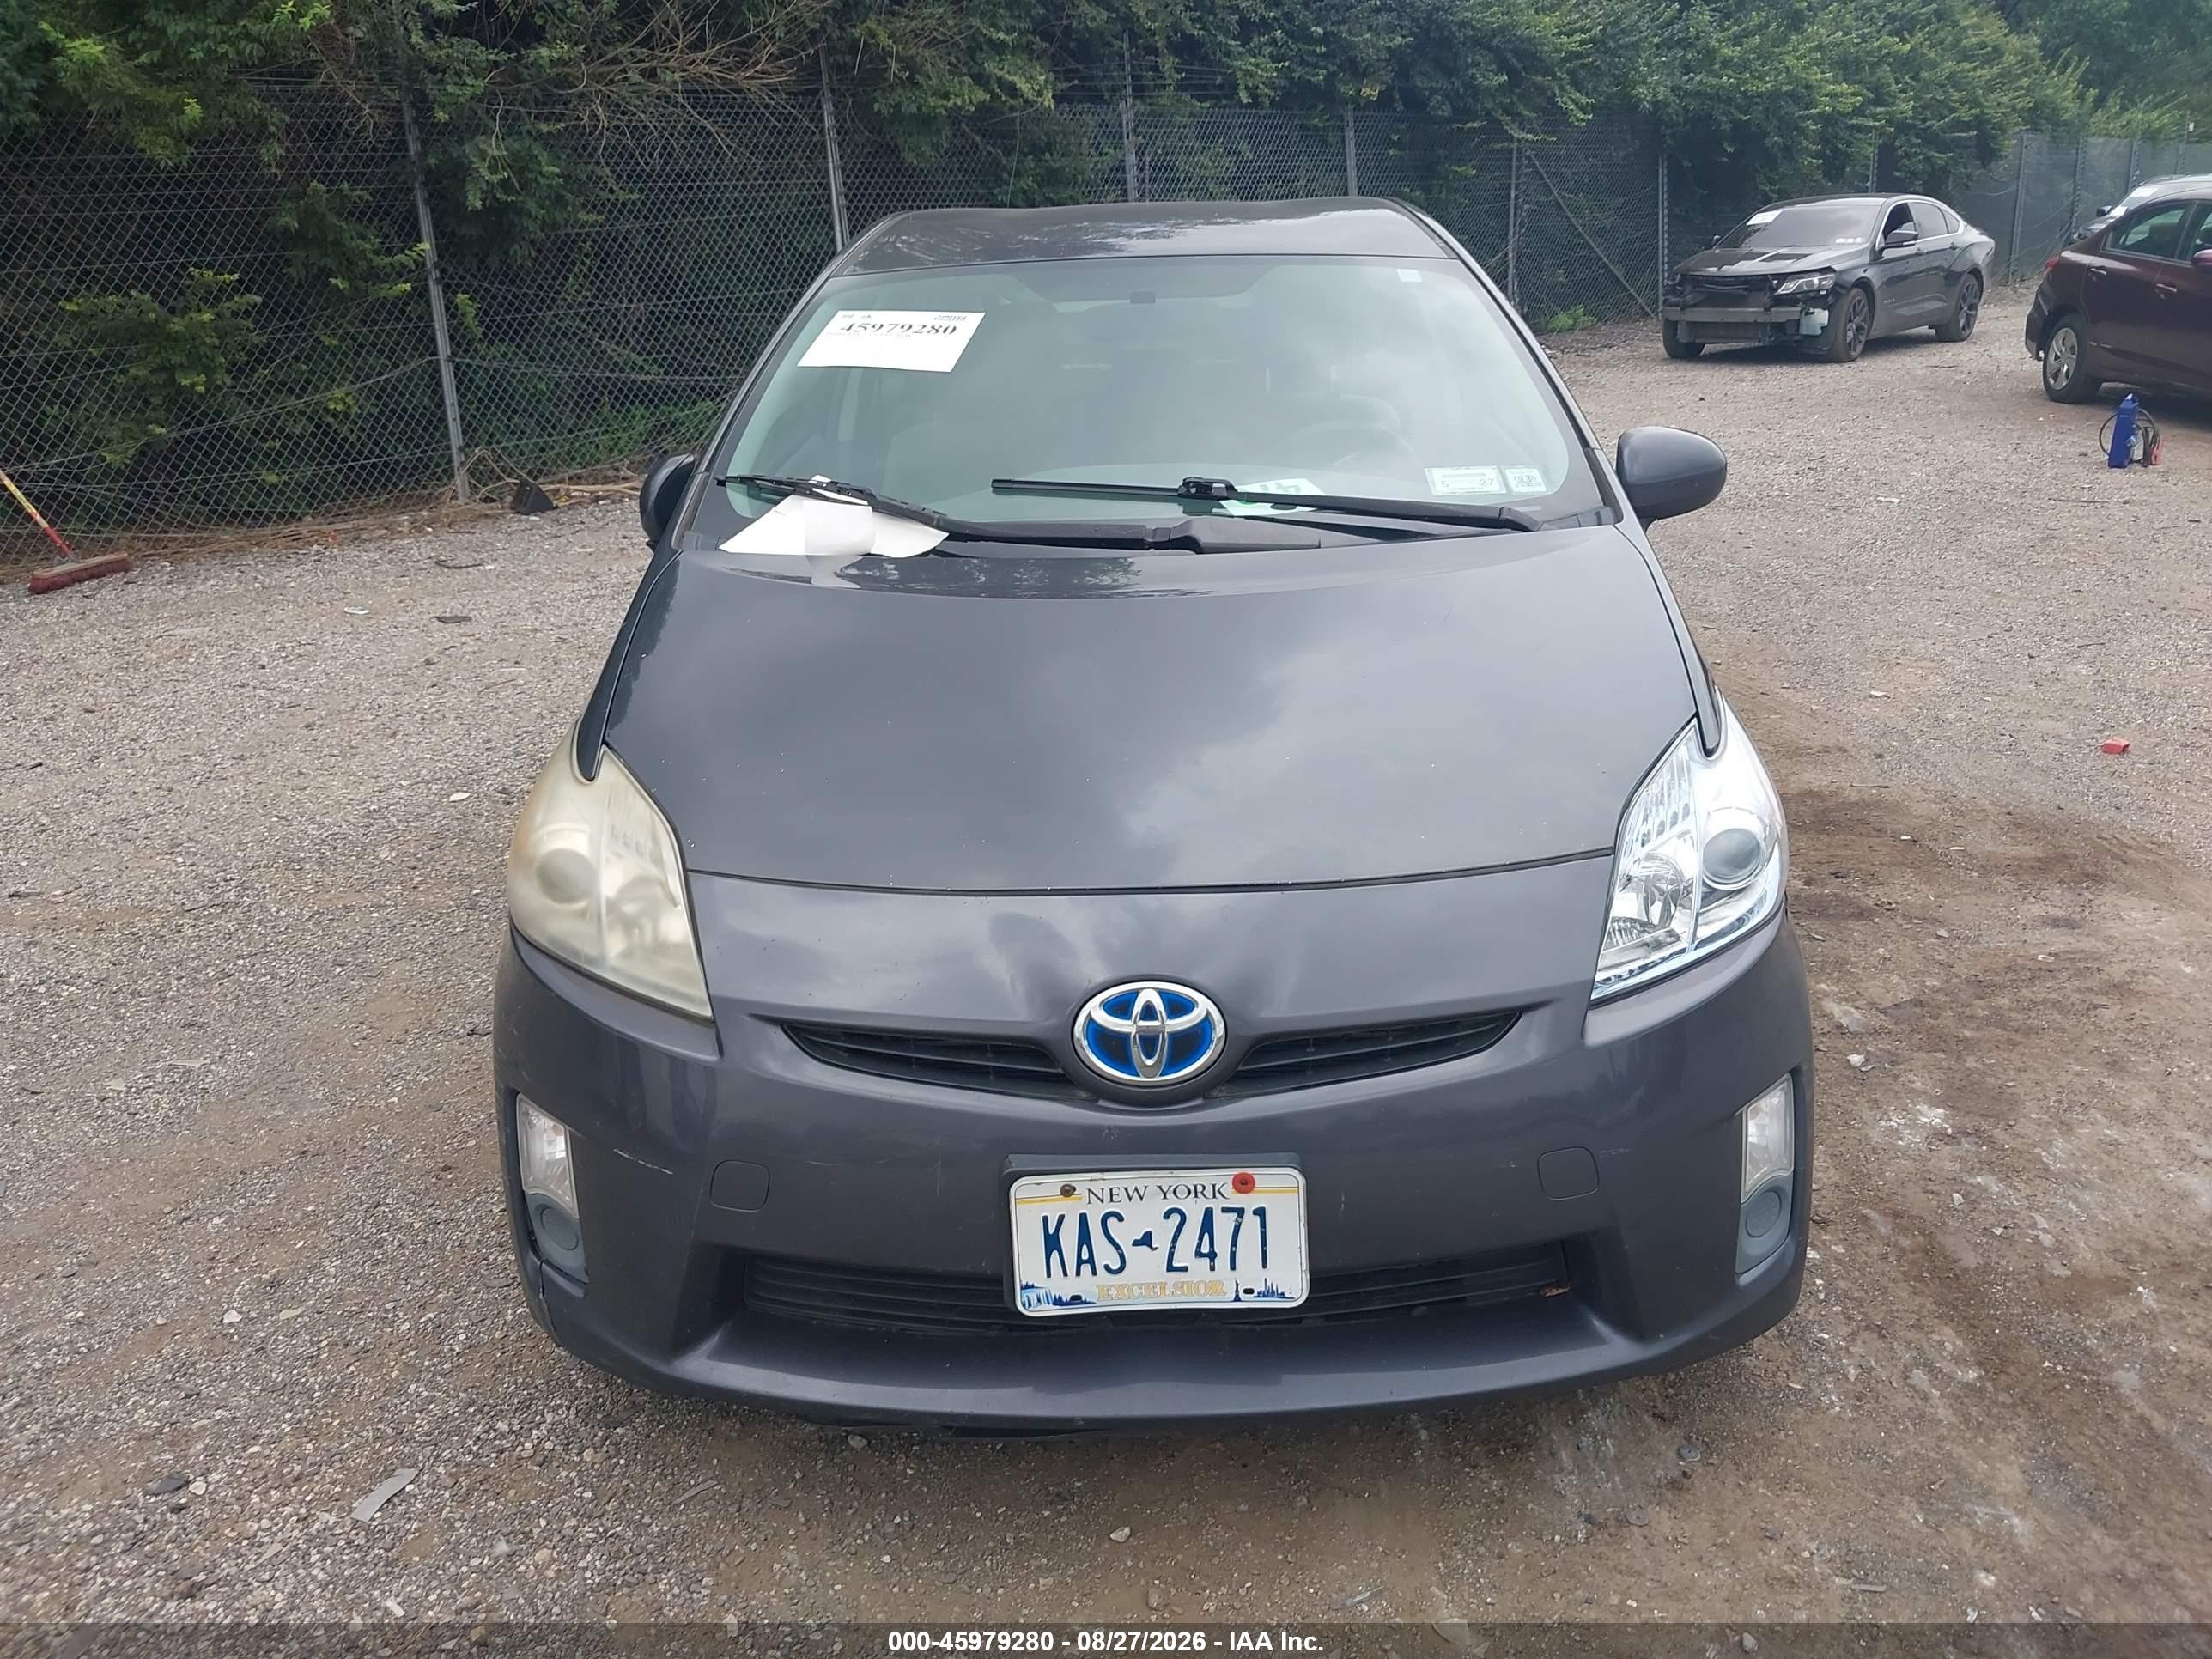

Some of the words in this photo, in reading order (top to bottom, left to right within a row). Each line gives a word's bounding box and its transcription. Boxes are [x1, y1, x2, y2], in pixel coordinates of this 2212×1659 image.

[839, 322, 957, 335] 45979280
[1086, 1184, 1151, 1205] NEW
[1157, 1181, 1231, 1201] YORK
[1096, 1279, 1228, 1302] EXCELSIOR
